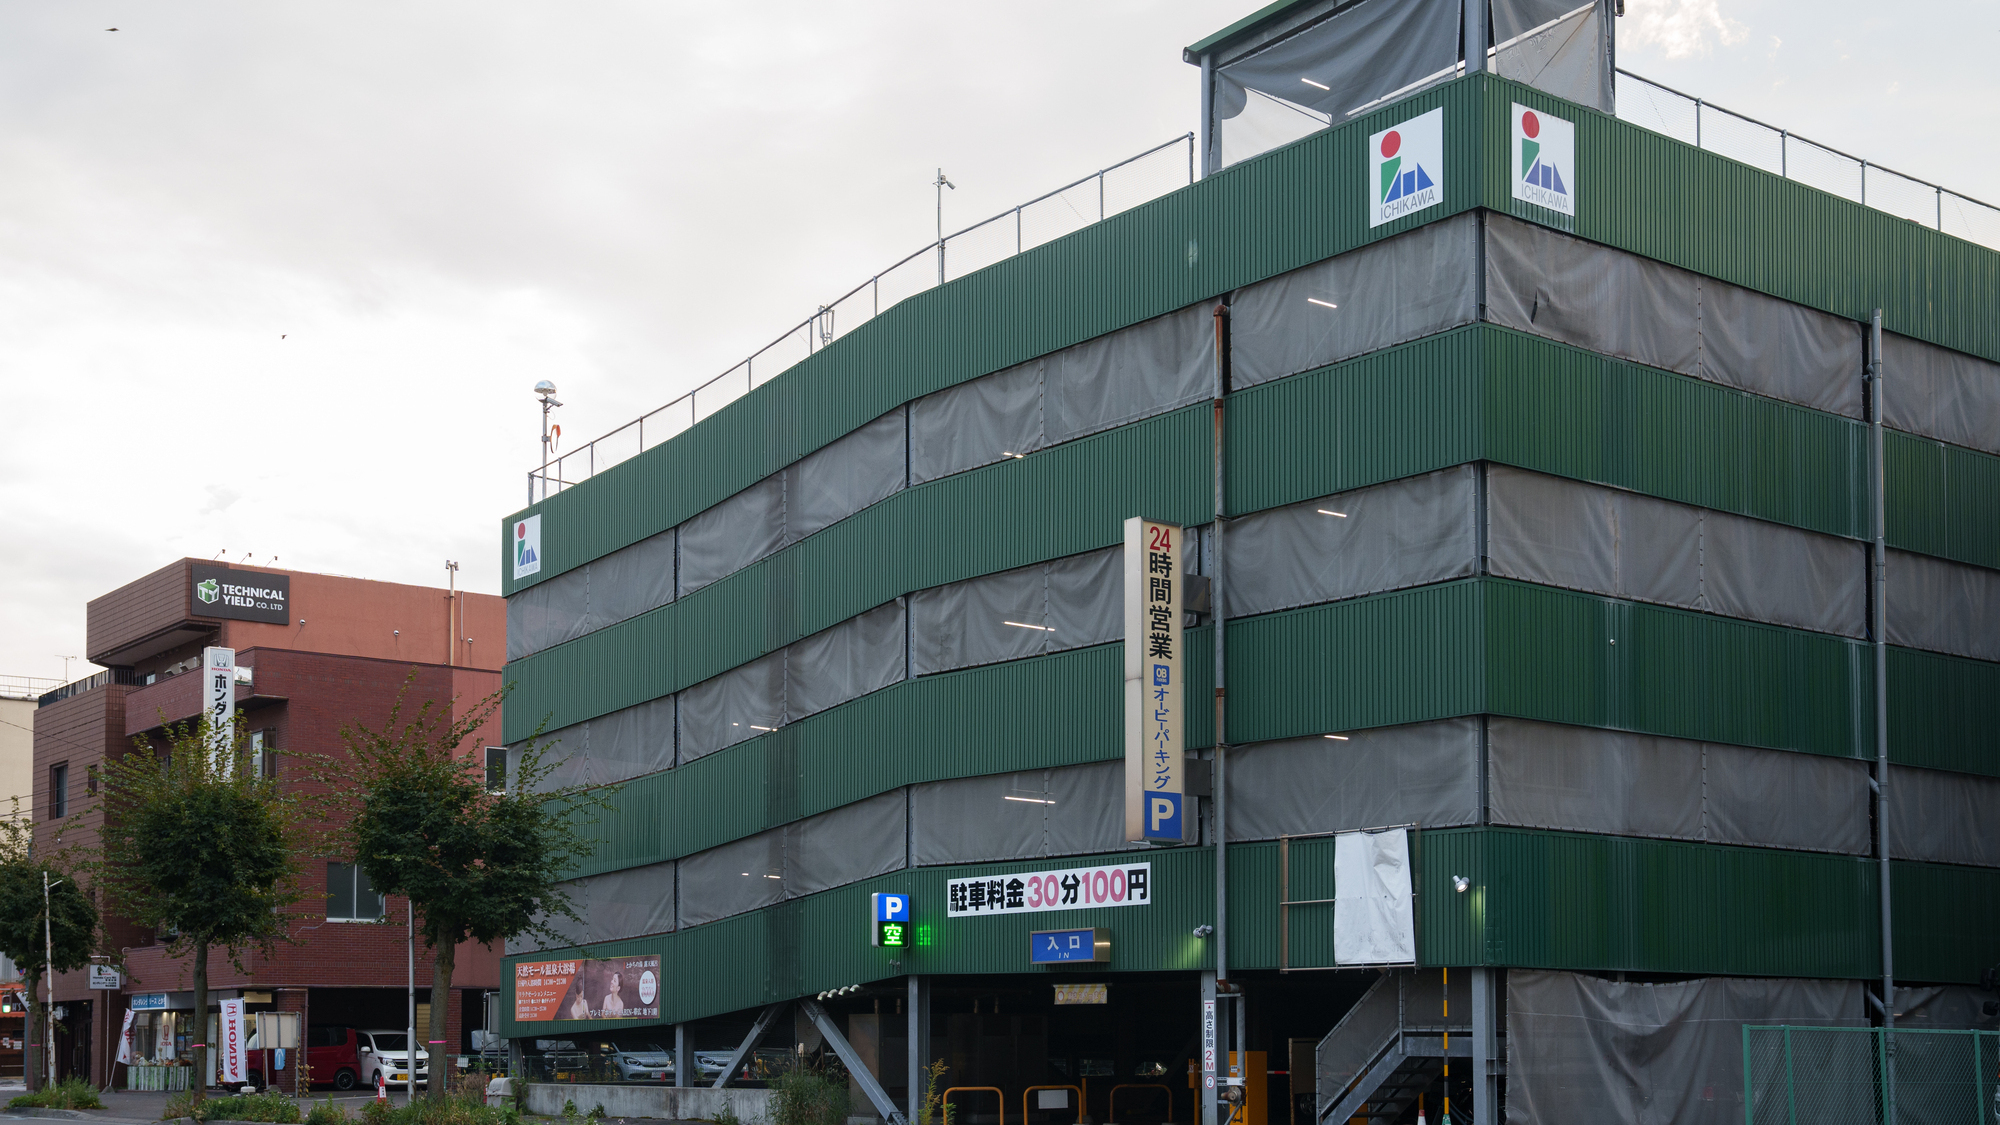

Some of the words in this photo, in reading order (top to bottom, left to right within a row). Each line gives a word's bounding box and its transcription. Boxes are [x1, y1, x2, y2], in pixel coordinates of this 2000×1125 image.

[1380, 188, 1435, 221] ICHIKAWA
[1521, 183, 1569, 211] ICHIKAWA
[222, 584, 285, 601] TECHNICAL
[222, 595, 254, 608] YIELD
[256, 602, 269, 610] CO.
[270, 603, 283, 611] LTD
[1149, 526, 1173, 660] 24時間営業
[1156, 668, 1167, 679] OB
[1153, 687, 1171, 790] オービーパーキング
[1151, 797, 1175, 832] P
[949, 868, 1148, 913] 駐車料金30分100円
[885, 896, 903, 920] P
[883, 923, 903, 946] 空
[517, 962, 576, 977] 天然モール温泉大浴場
[1207, 1078, 1213, 1086] 2
